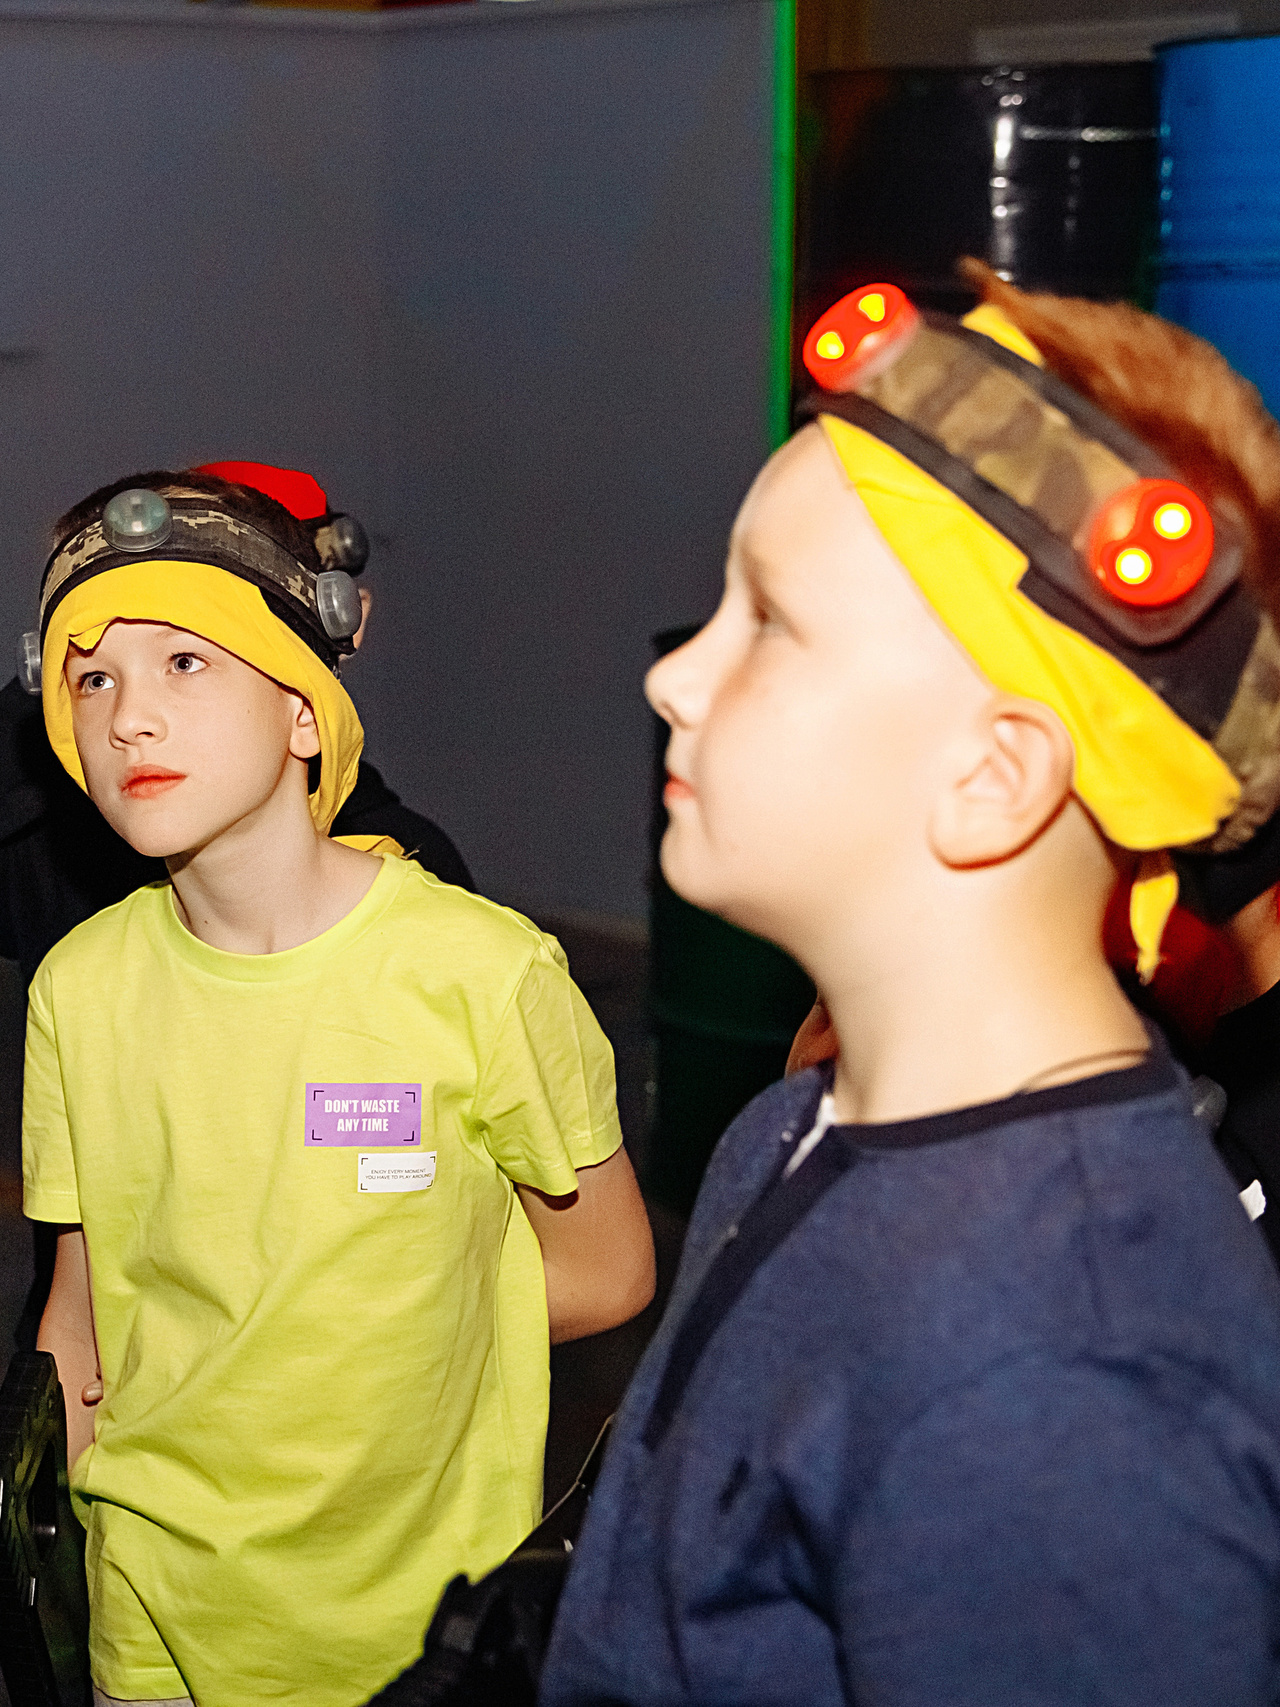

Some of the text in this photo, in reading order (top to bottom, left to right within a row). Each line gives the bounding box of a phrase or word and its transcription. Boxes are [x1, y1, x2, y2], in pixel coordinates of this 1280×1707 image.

[324, 1099, 400, 1114] DON'T WASTE
[336, 1118, 389, 1132] ANY TIME
